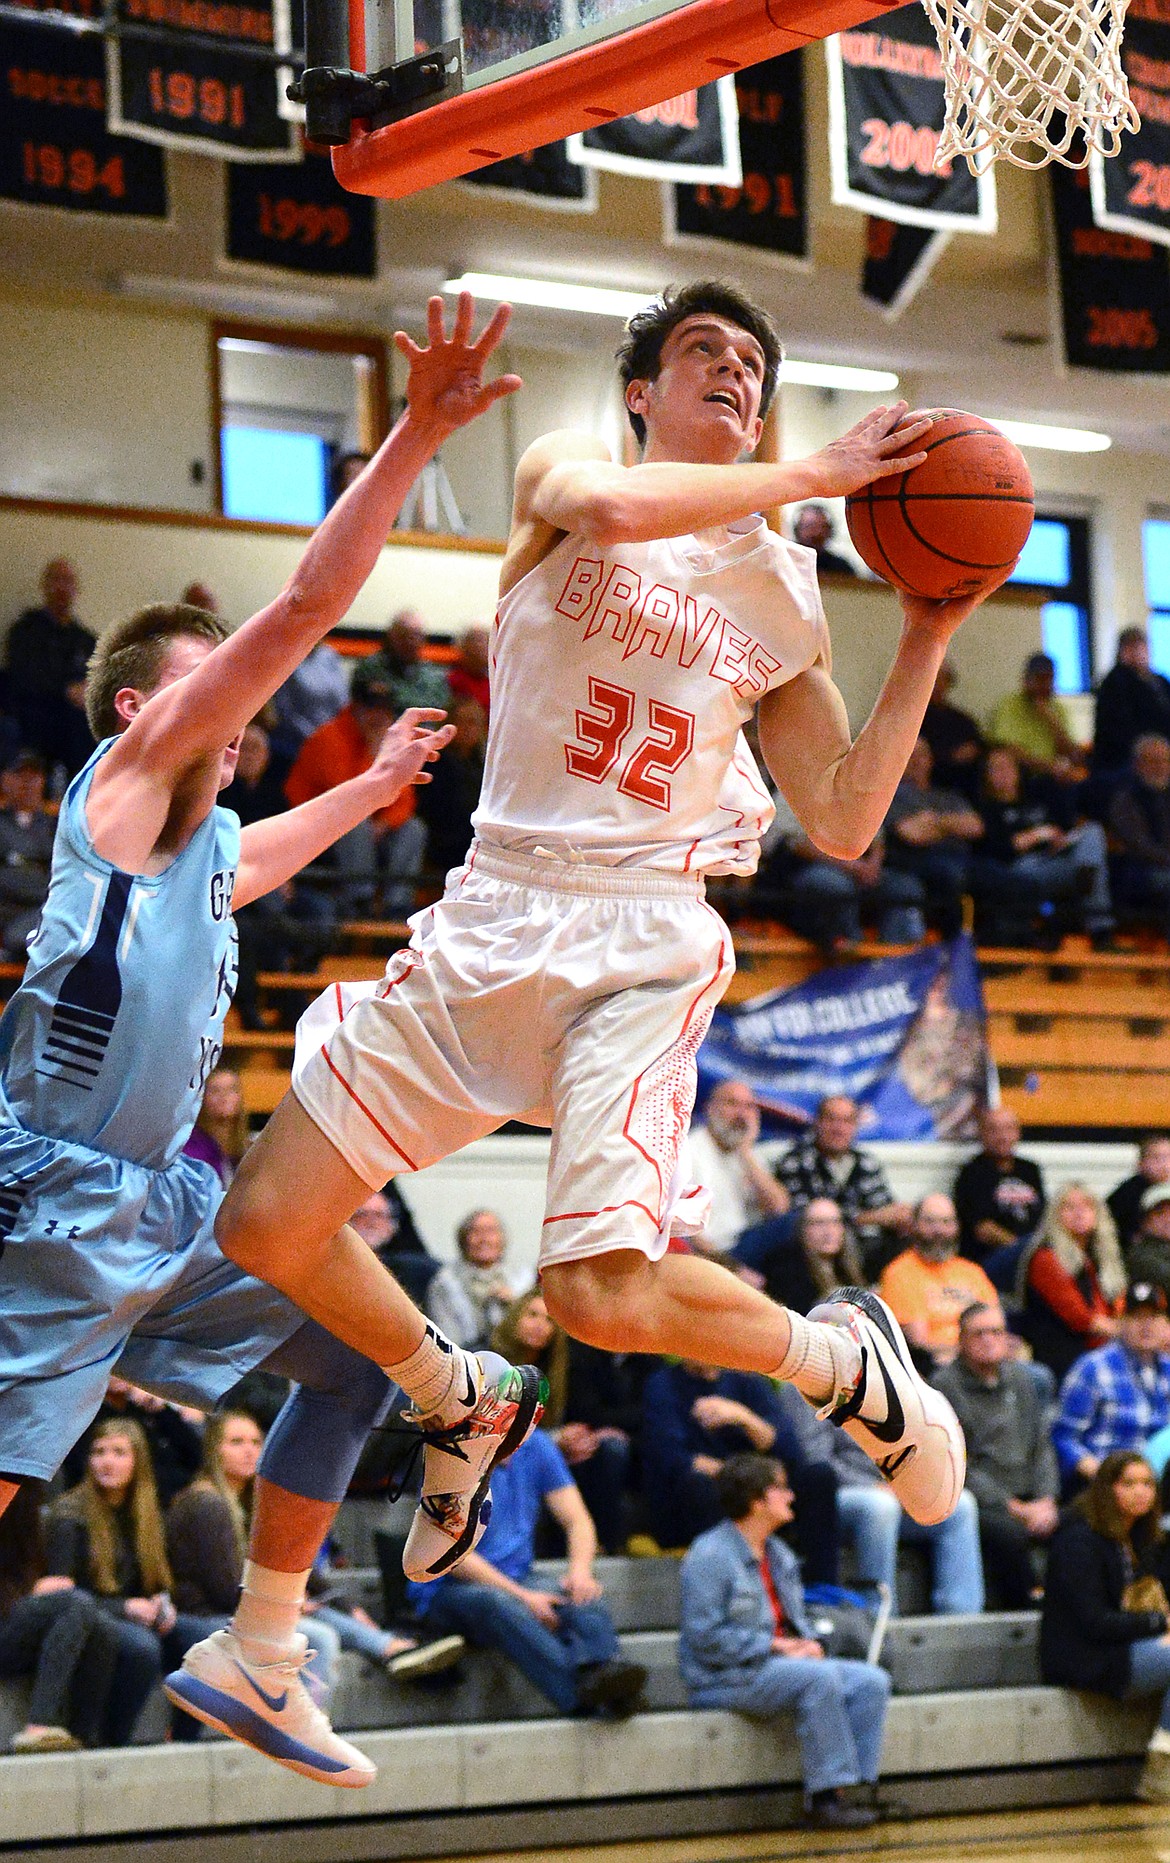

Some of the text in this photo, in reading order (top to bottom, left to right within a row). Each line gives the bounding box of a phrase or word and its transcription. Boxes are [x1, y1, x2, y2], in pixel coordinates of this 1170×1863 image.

[149, 66, 245, 129] 1991
[23, 140, 126, 198] 1994
[258, 193, 350, 248] 1999
[554, 556, 783, 699] BRAVES
[564, 674, 696, 813] 32
[813, 980, 919, 1035] COLLEGE
